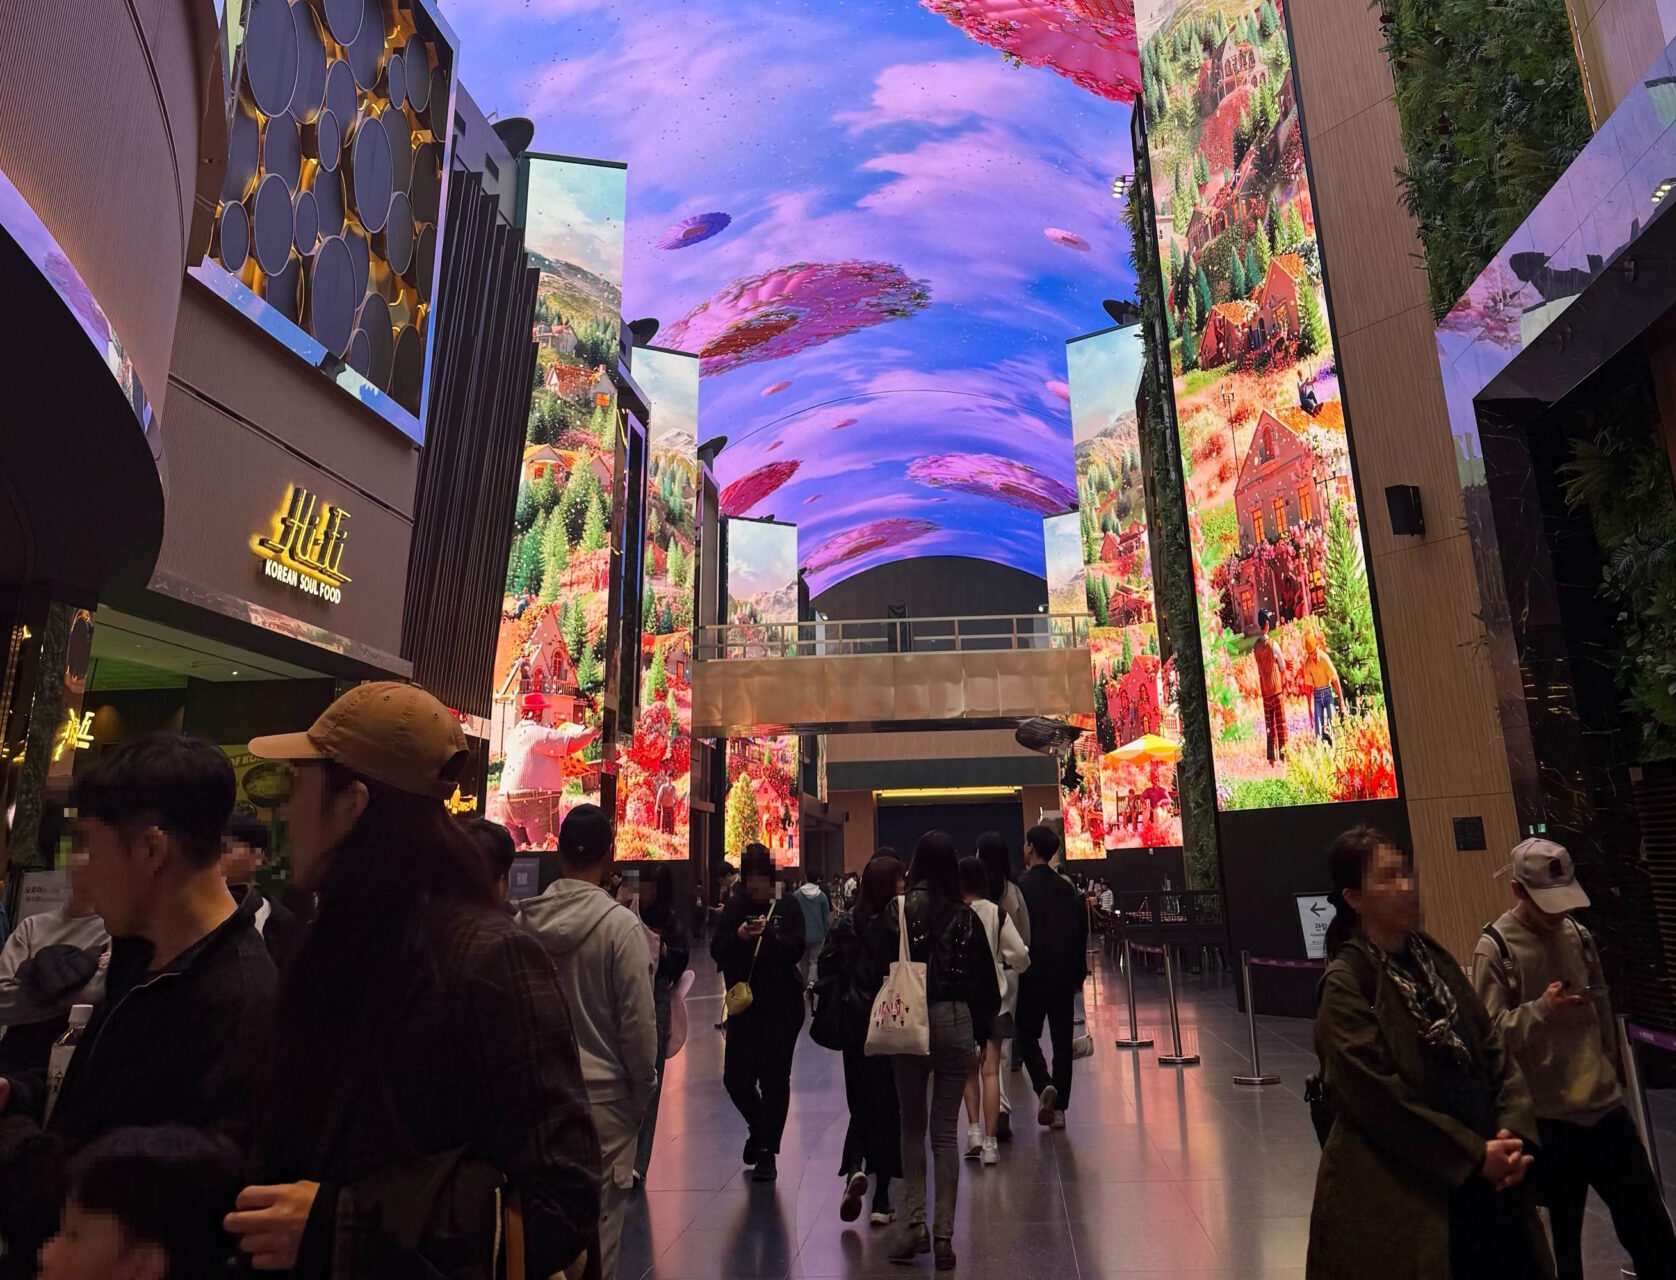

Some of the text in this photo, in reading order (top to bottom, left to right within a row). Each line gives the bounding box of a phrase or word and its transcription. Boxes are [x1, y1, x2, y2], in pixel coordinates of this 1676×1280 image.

[265, 559, 341, 605] KOREAN SOUL FOOD
